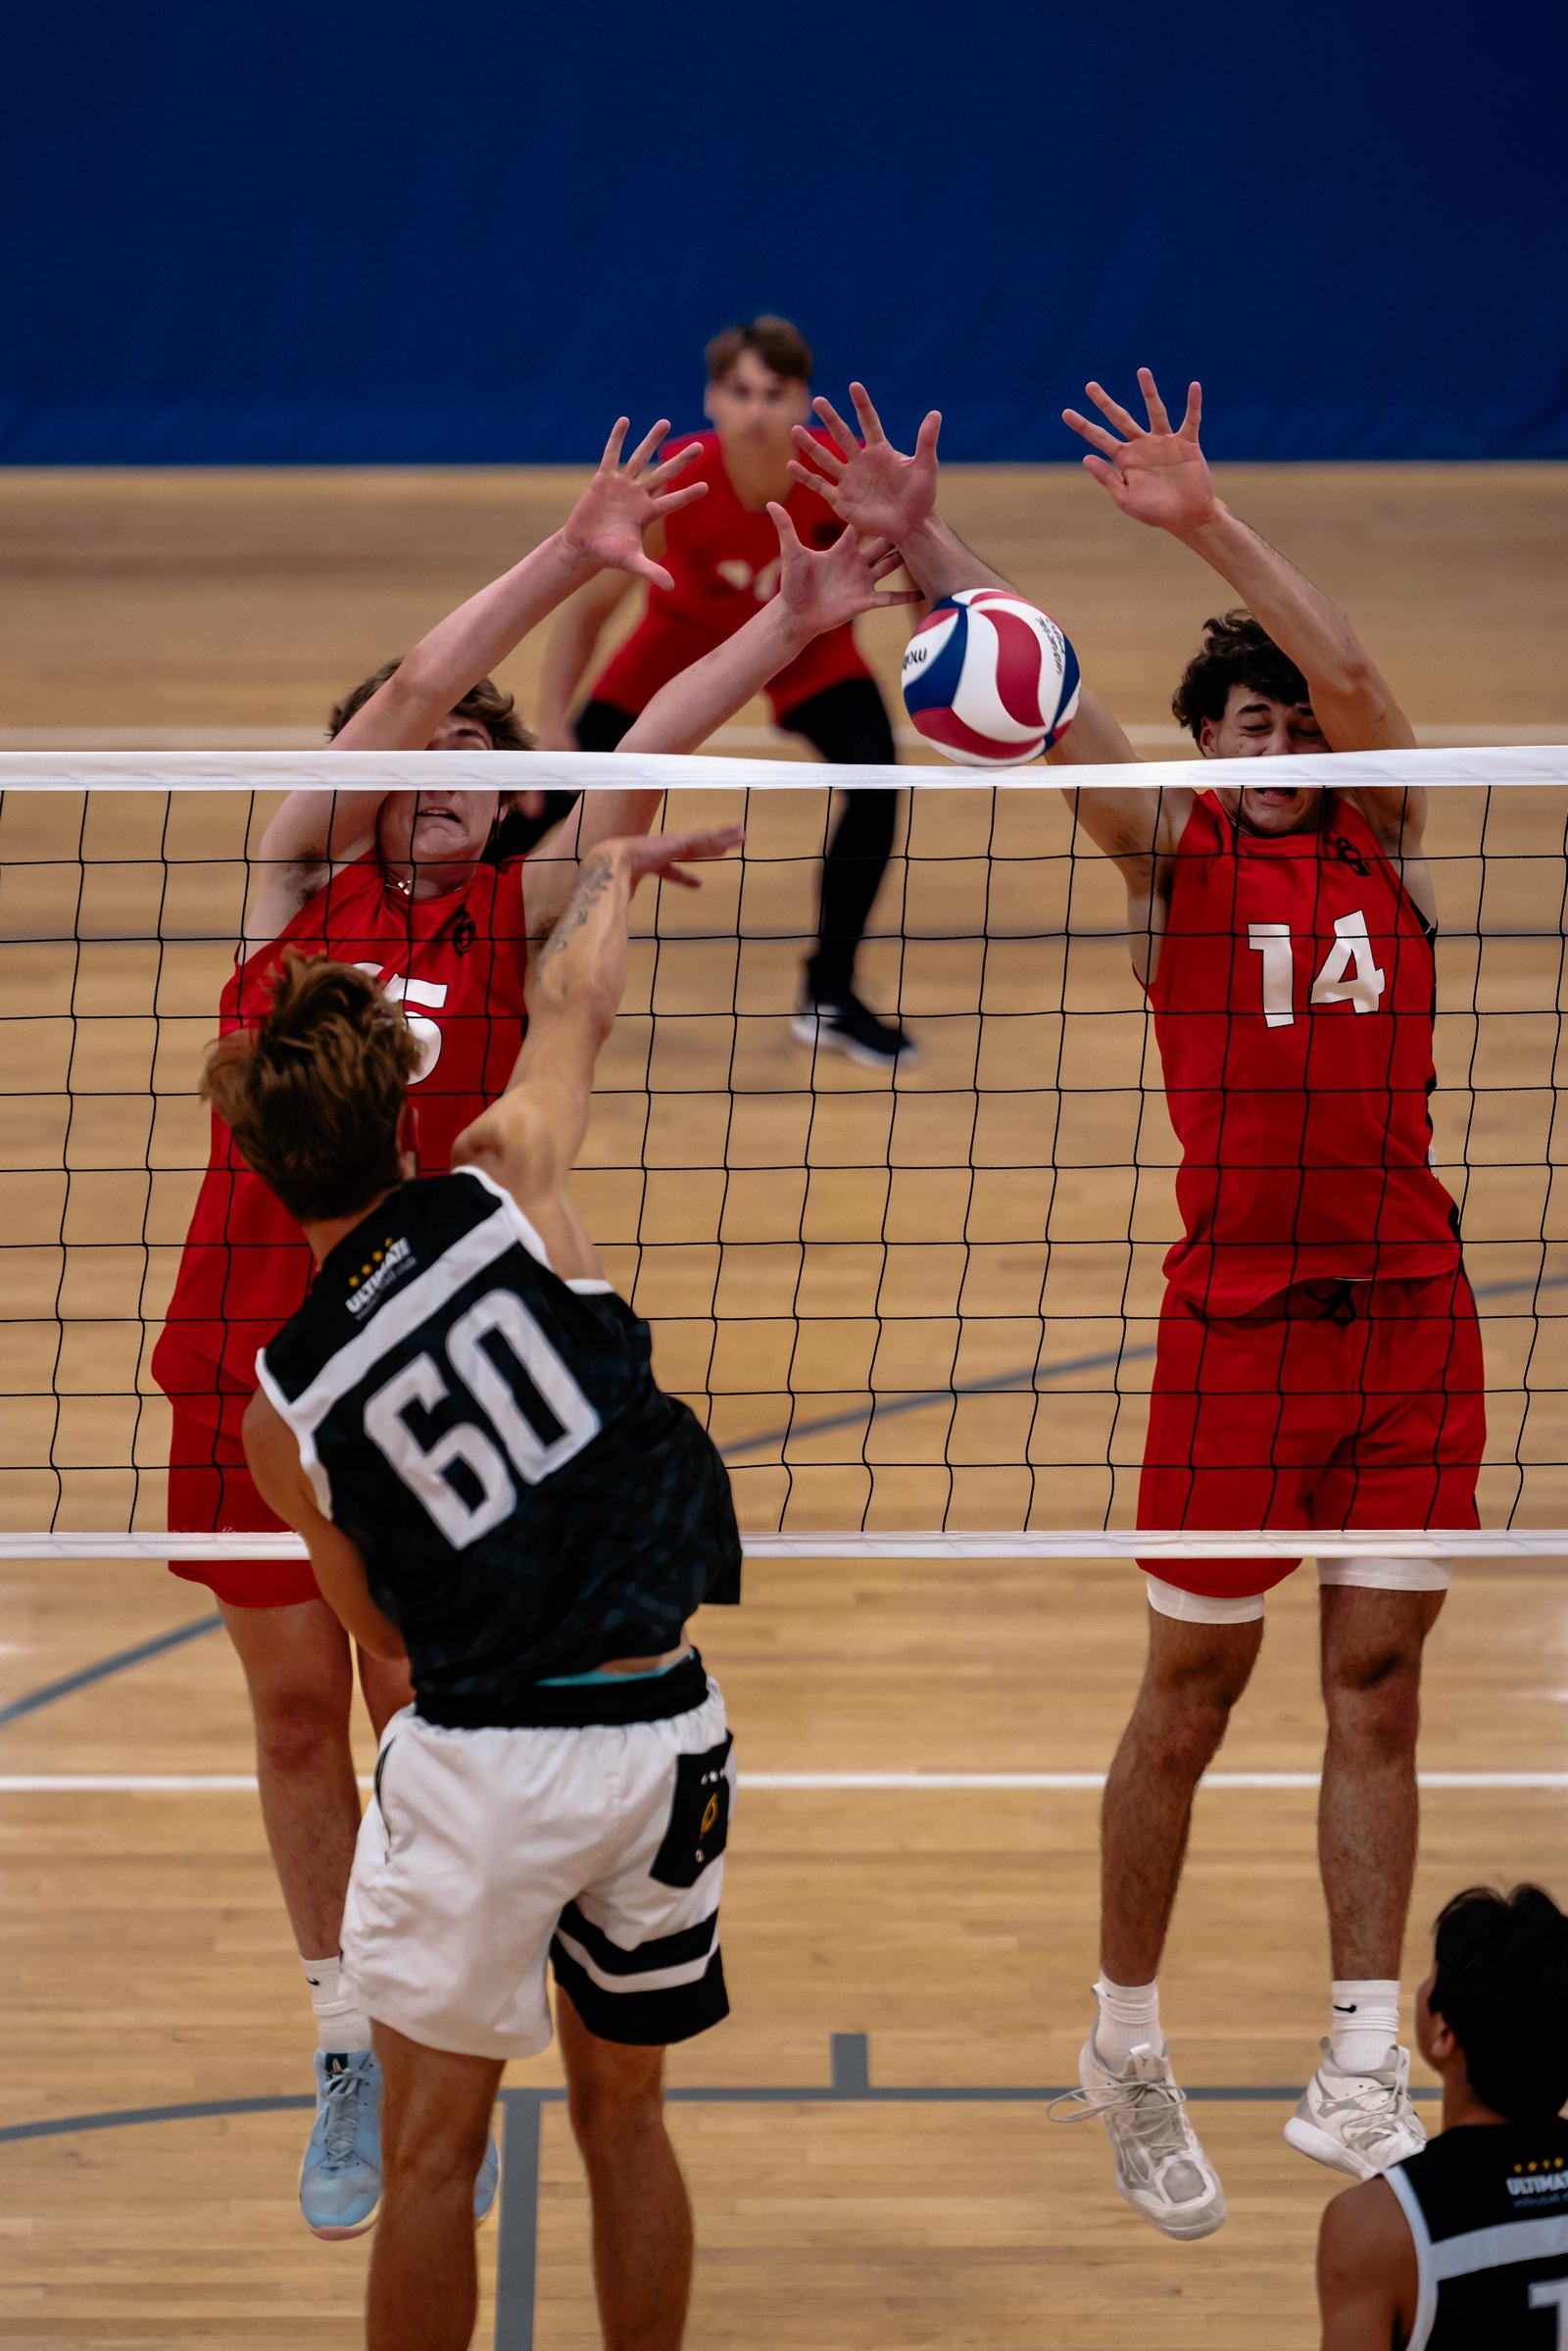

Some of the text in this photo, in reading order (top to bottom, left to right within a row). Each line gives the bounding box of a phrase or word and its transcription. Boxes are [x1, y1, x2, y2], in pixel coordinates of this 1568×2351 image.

[350, 961, 449, 1087] 5
[1248, 908, 1386, 1029] 14
[364, 1289, 600, 1550] 60
[1505, 2171, 1568, 2195] ULTIMAT
